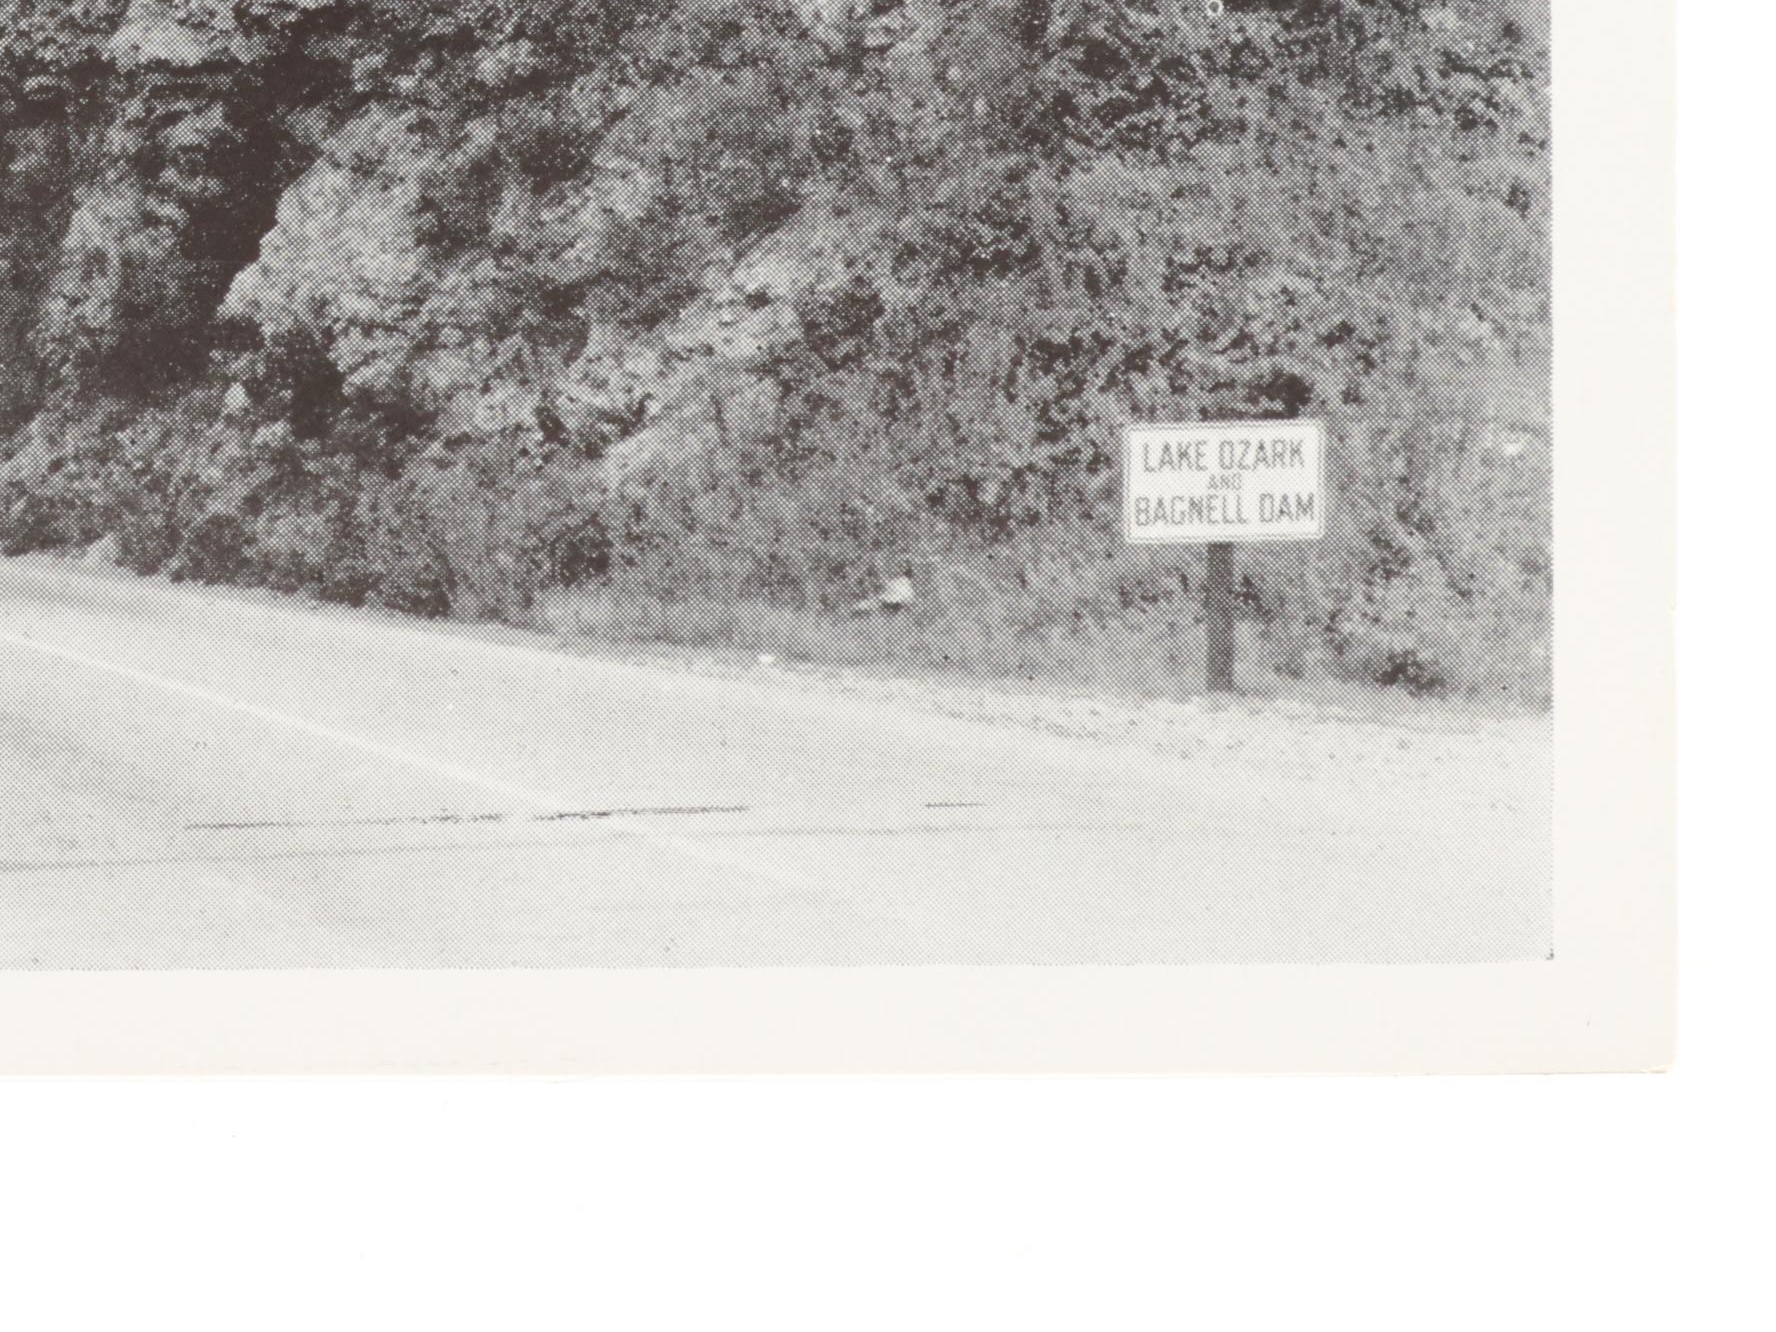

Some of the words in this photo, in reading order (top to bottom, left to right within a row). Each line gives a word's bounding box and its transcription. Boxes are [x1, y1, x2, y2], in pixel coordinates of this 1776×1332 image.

[1143, 440, 1208, 472] LAKE
[1219, 438, 1303, 470] OZARK
[1208, 473, 1242, 490] AND
[1135, 494, 1249, 526] BAGNELL
[1259, 492, 1315, 523] DAM
